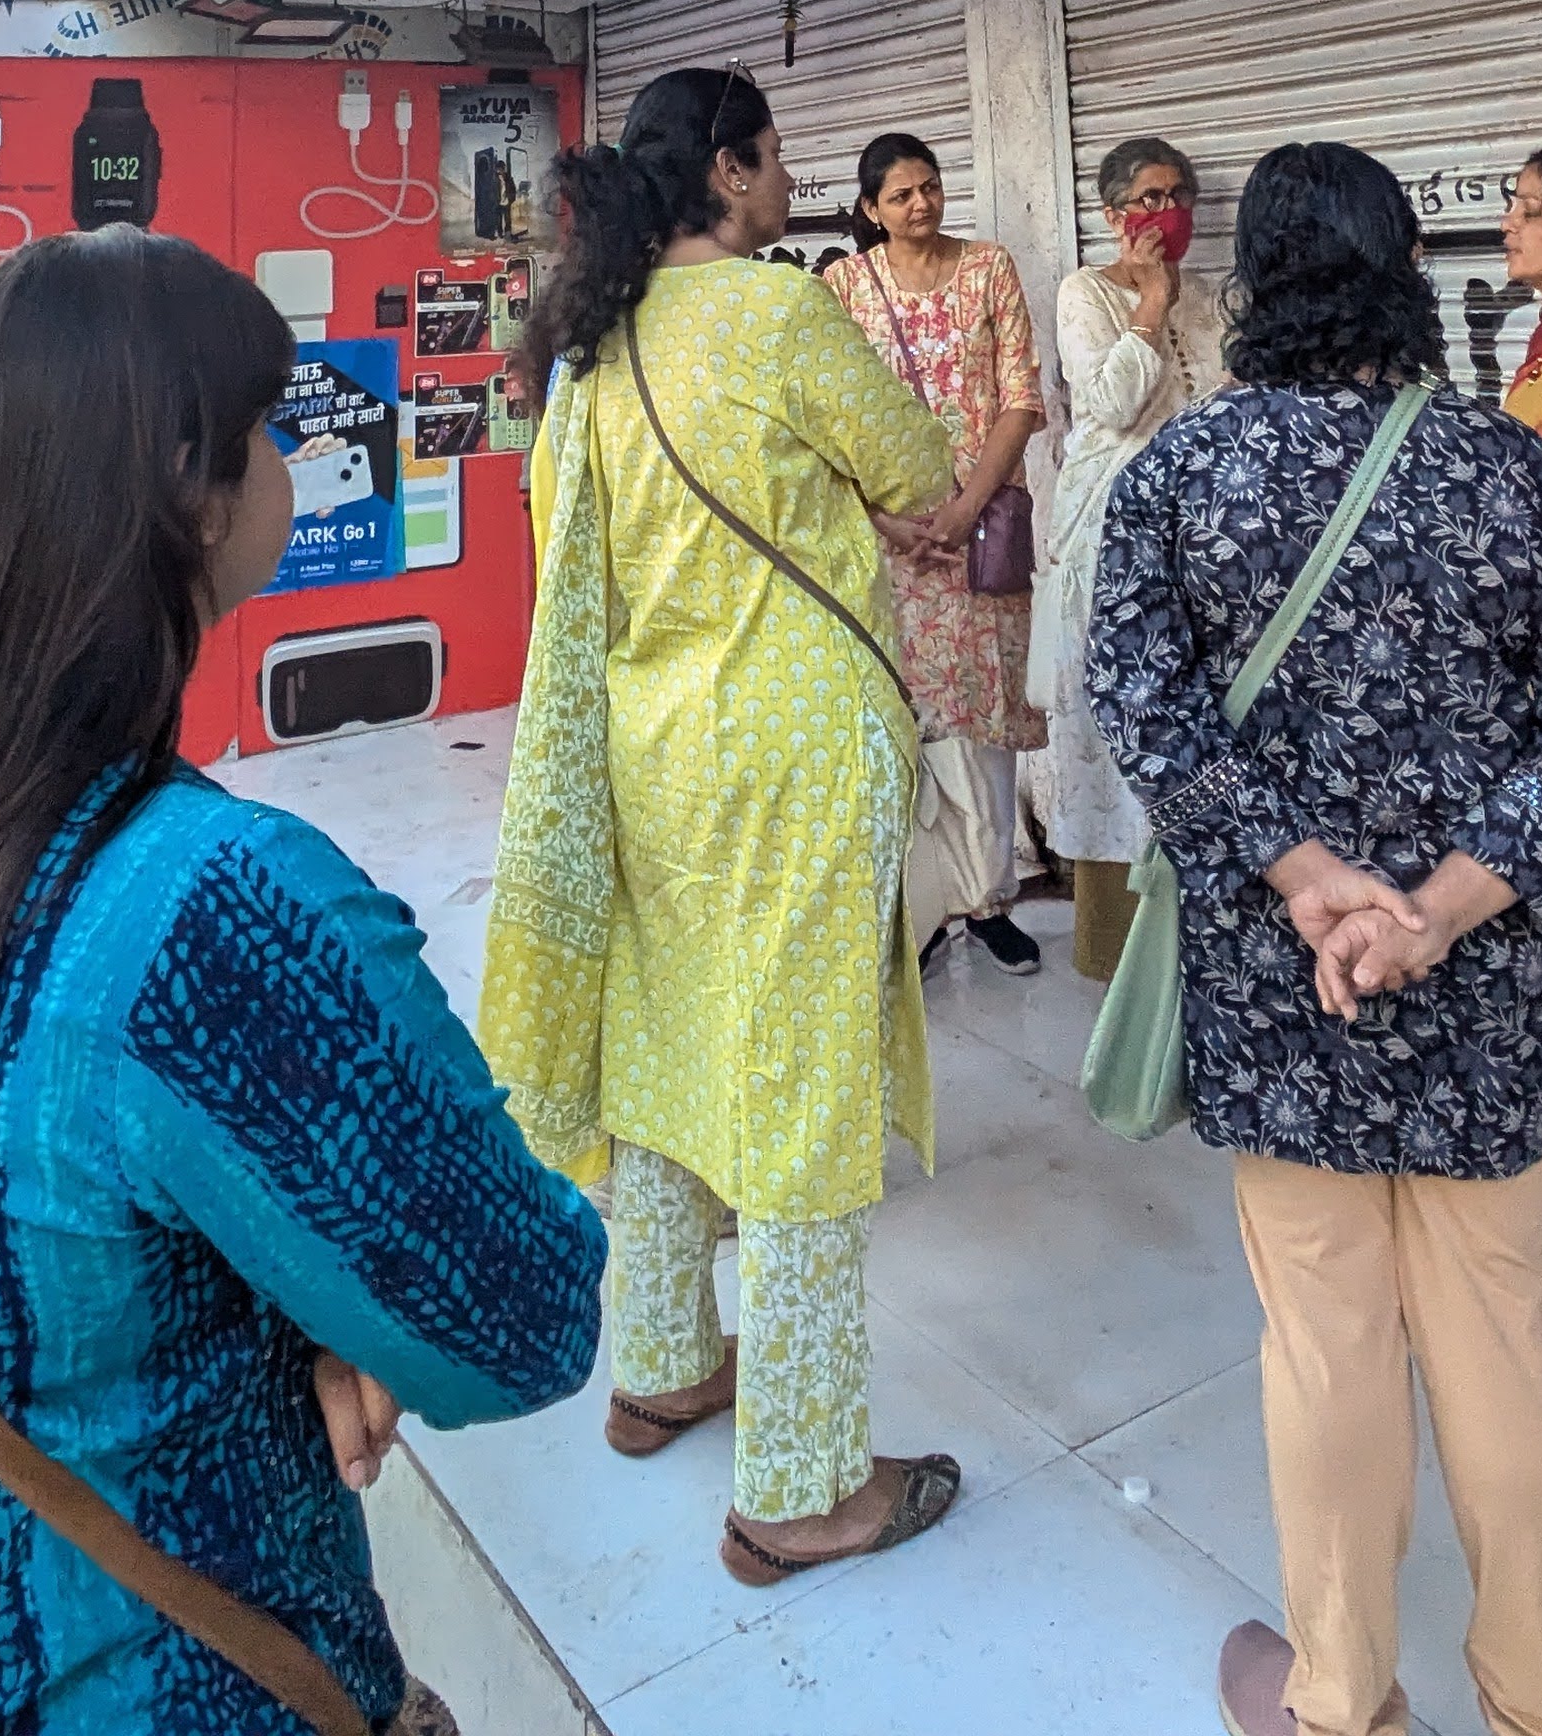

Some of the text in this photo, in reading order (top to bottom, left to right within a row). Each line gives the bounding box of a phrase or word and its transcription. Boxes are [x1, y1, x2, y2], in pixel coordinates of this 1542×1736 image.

[479, 97, 531, 115] YUVA
[90, 156, 140, 181] 10:32
[331, 408, 356, 429] आहे
[357, 402, 385, 425] सारी
[343, 524, 365, 541] Go
[368, 521, 376, 539] 1
